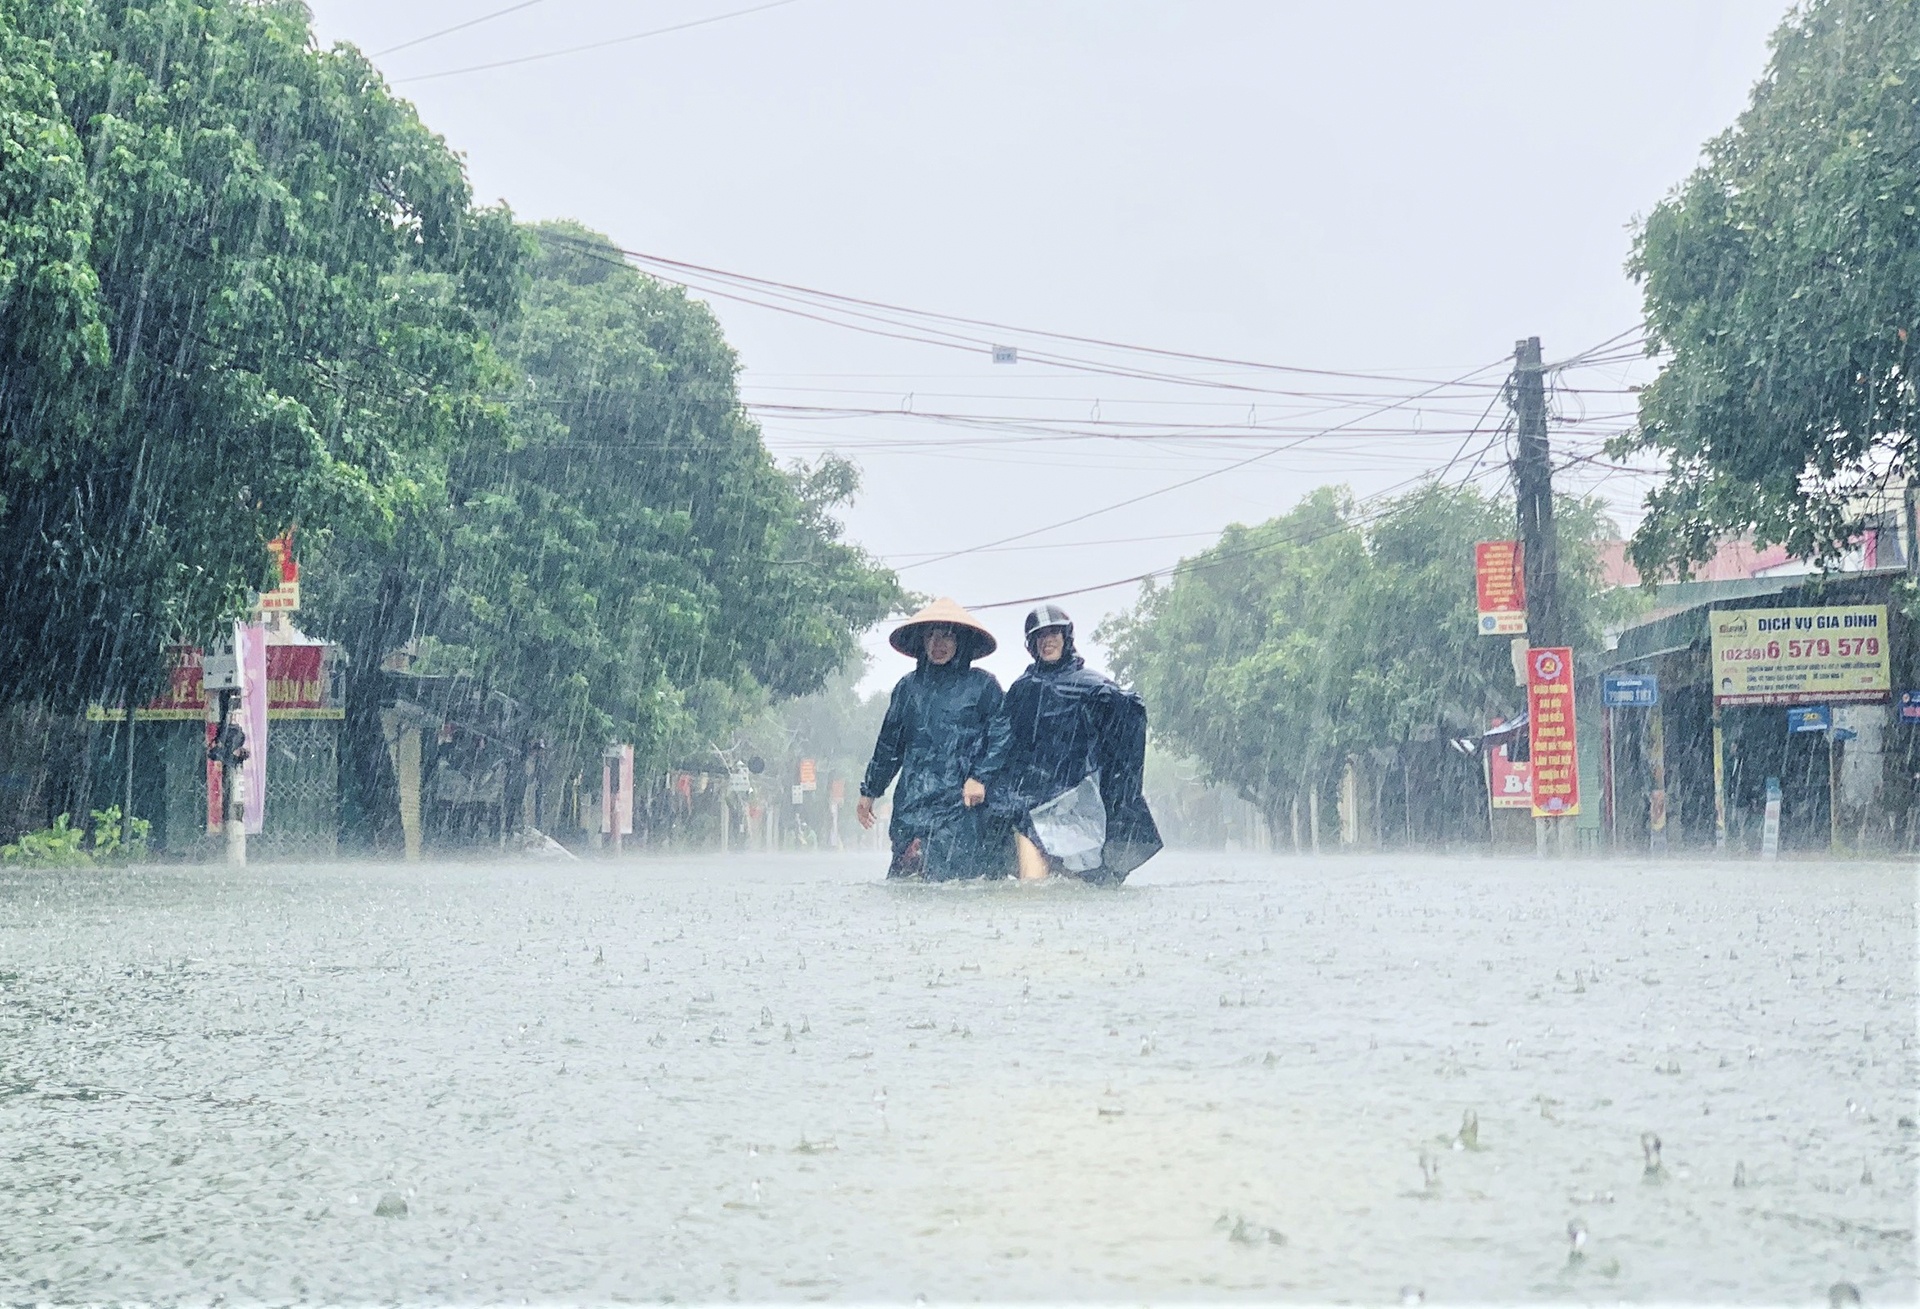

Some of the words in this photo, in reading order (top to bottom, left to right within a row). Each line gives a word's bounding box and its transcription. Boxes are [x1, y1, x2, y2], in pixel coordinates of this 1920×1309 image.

[1758, 617, 1791, 634] DỊCH
[1795, 616, 1813, 633] VỤ
[1817, 616, 1840, 629] GIA
[1844, 612, 1878, 628] ĐÌNH
[1788, 639, 1830, 658] 579
[1838, 637, 1879, 657] 579
